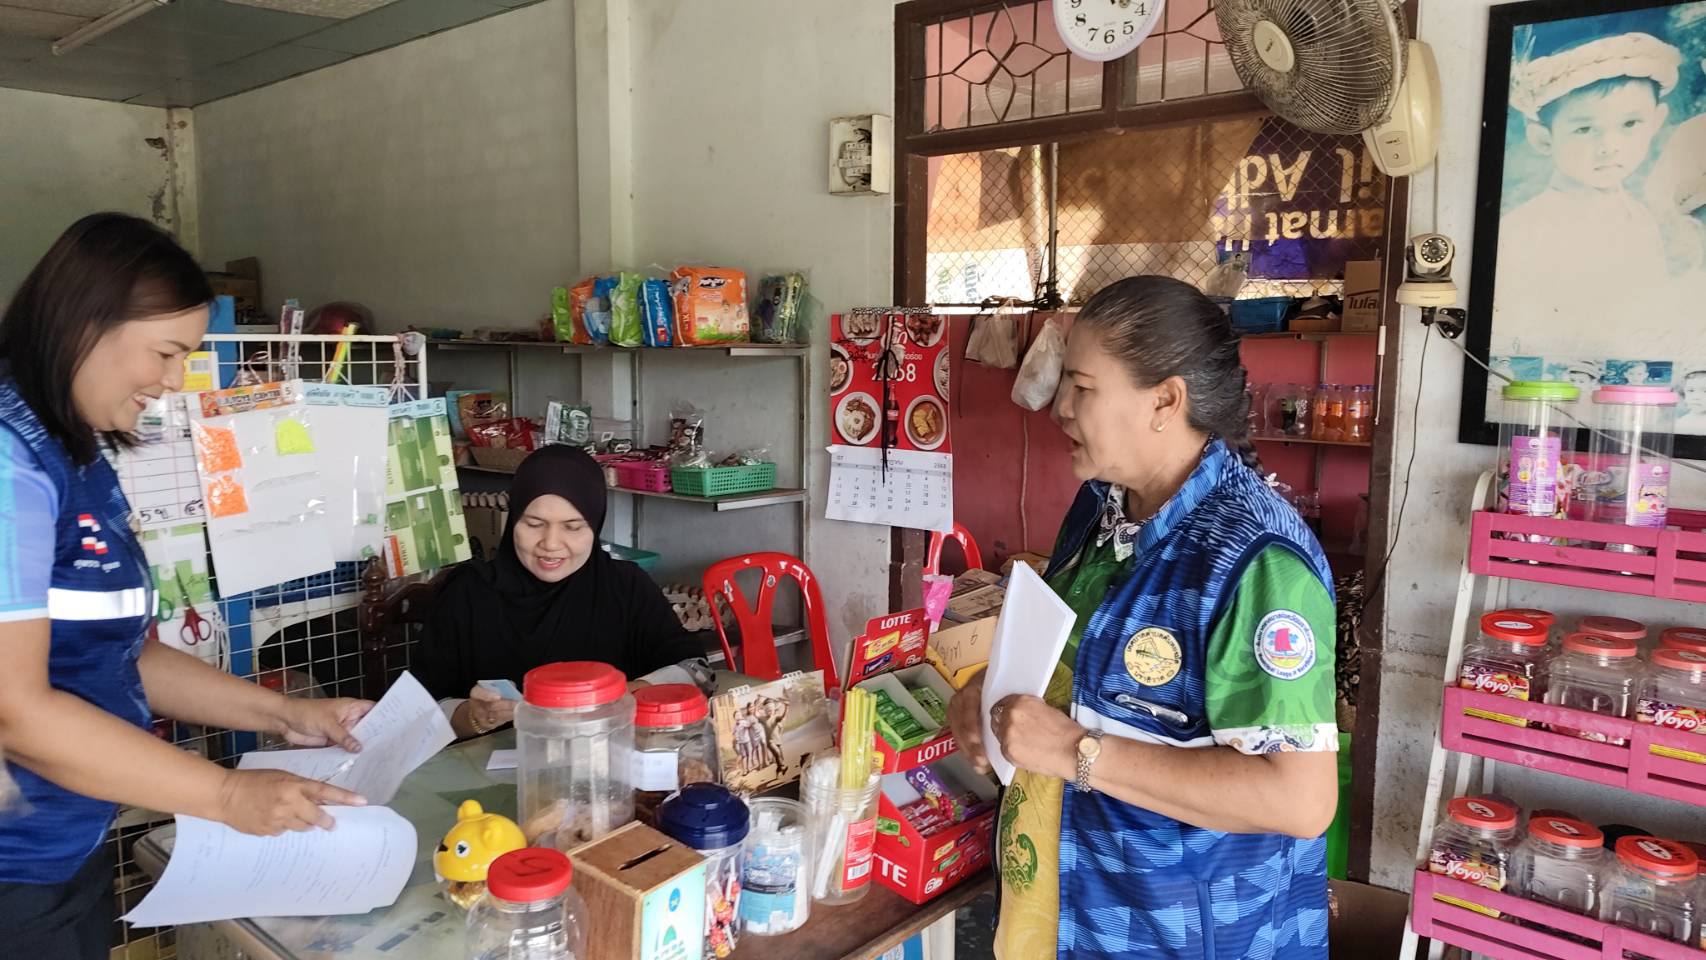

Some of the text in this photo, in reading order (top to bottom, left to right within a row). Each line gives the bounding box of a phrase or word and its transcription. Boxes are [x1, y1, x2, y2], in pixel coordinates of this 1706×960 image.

[1134, 3, 1147, 16] 4
[1075, 13, 1086, 27] 8
[1088, 27, 1099, 41] 7
[1122, 21, 1134, 35] 5
[1104, 30, 1115, 44] 6
[880, 614, 912, 630] LOTTE
[1654, 708, 1698, 729] Yoyo
[917, 738, 957, 763] LOTTE
[916, 771, 943, 798] Grape
